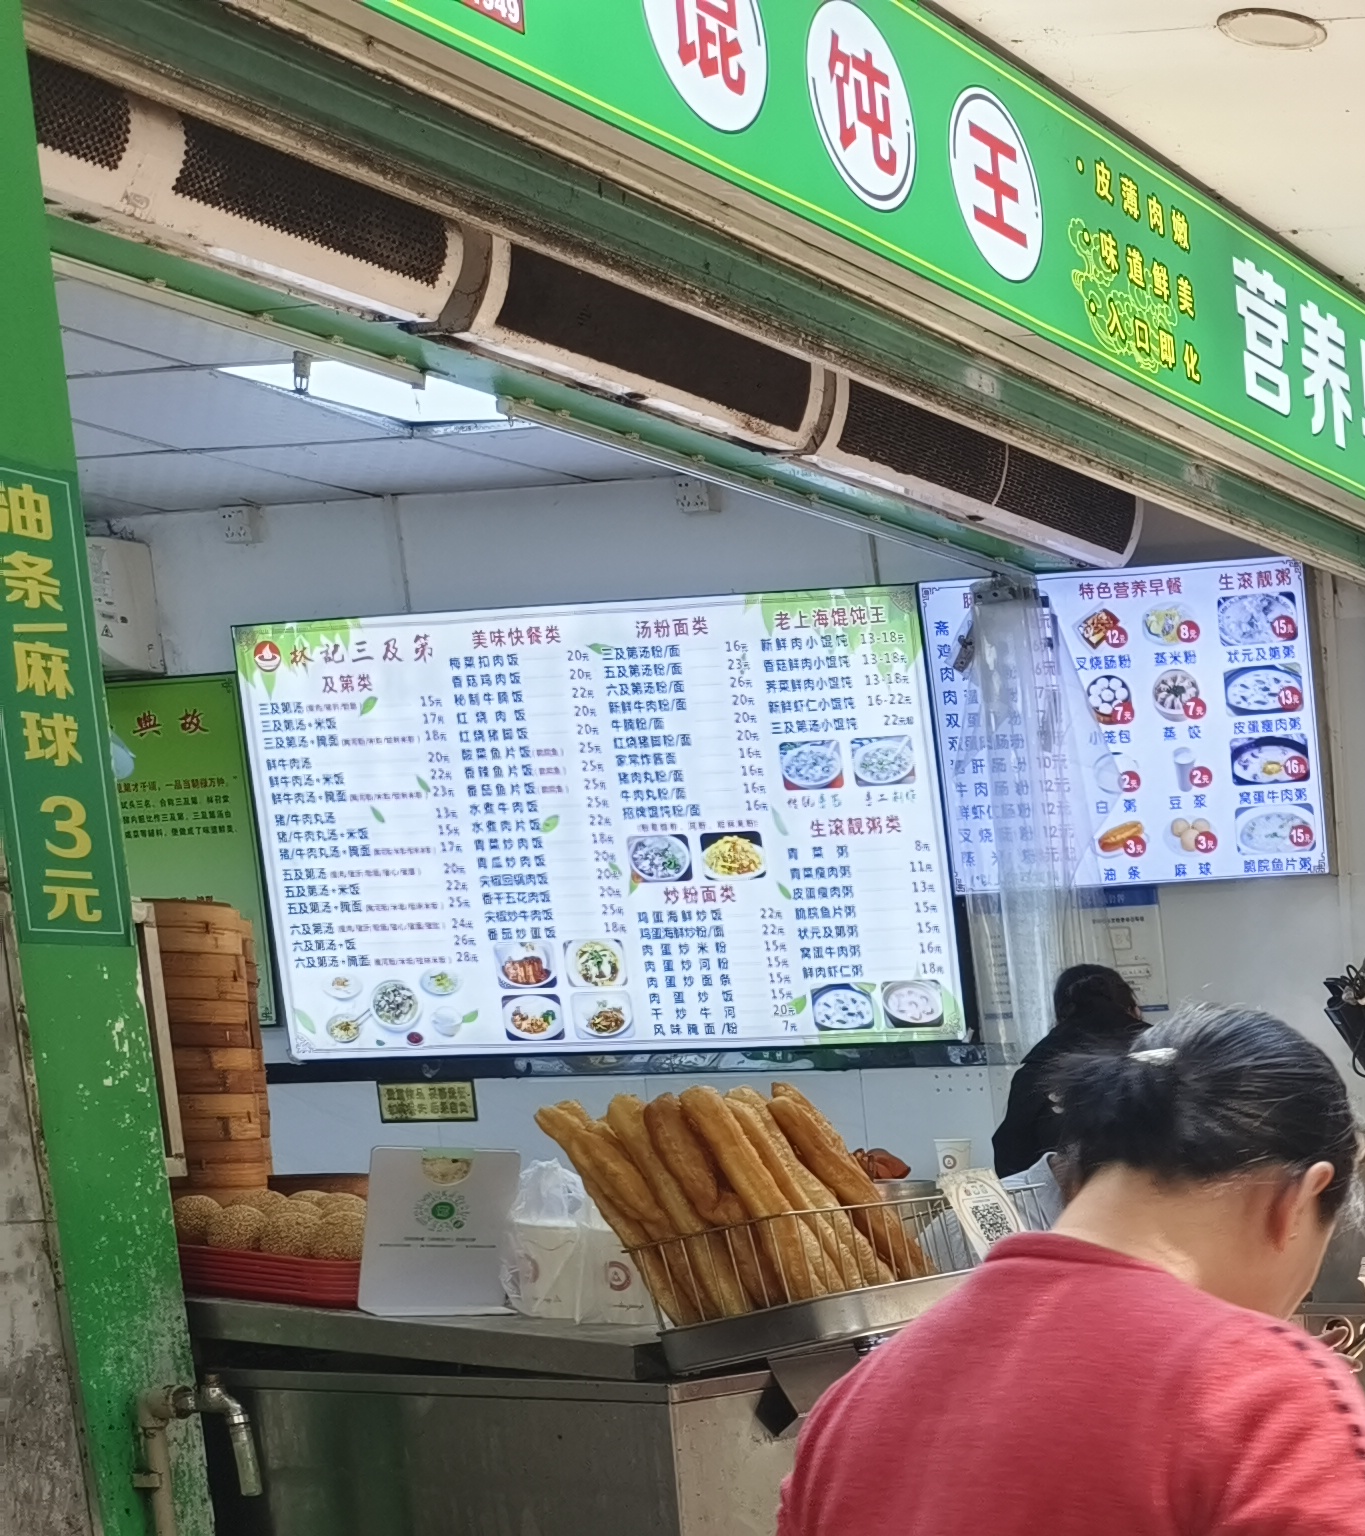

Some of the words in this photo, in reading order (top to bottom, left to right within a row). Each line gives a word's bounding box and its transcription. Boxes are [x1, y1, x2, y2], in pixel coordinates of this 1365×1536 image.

[1094, 160, 1191, 252] 皮薄肉嫩
[1098, 230, 1195, 318] 味道鲜美
[1107, 298, 1202, 385] 入口即化
[1218, 569, 1292, 591] 生滚靓粥
[1079, 577, 1182, 600] 特色营养早餐
[774, 605, 886, 631] 老上海馄饨王
[636, 616, 709, 639] 汤粉面类
[1180, 625, 1197, 639] 8元
[1273, 620, 1293, 635] 15元
[472, 625, 561, 649] 美味快餐类
[860, 632, 905, 644] 13-18元
[1106, 629, 1126, 644] 12元
[725, 641, 748, 652] 16元
[567, 650, 590, 662] 20元
[862, 653, 907, 665] 13-18元
[728, 659, 750, 670] 23元
[569, 668, 592, 680] 20元
[865, 674, 910, 686] 13-18元
[730, 676, 752, 688] 26元
[572, 687, 594, 699] 22元
[1279, 690, 1299, 704] 13元
[420, 696, 443, 707] 15元
[732, 694, 755, 706] 20元
[867, 694, 912, 706] 16-22元
[574, 705, 597, 717] 20元
[1113, 707, 1131, 720] 7元
[1186, 702, 1204, 716] 7元
[423, 713, 444, 725] 17元
[734, 712, 757, 724] 20元
[425, 730, 447, 741] 18元
[576, 724, 599, 736] 20元
[736, 730, 760, 742] 20元
[579, 742, 602, 754] 25元
[739, 748, 762, 759] 16元
[428, 752, 450, 763] 20元
[581, 760, 604, 772] 25元
[741, 766, 764, 777] 16元
[1285, 760, 1306, 774] 16元
[430, 768, 452, 780] 22元
[1192, 770, 1210, 784] 2元
[584, 778, 607, 790] 25元
[743, 783, 766, 794] 16元
[1122, 776, 1138, 789] 2元
[433, 785, 455, 797] 23元
[586, 796, 609, 808] 25元
[745, 800, 768, 811] 16元
[435, 807, 458, 819] 13元
[589, 814, 612, 826] 22元
[438, 824, 459, 836] 15元
[809, 815, 902, 838] 生滚靓粥类
[1291, 829, 1311, 843] 15元
[440, 841, 463, 853] 17元
[915, 841, 930, 851] 8元
[1127, 840, 1143, 853] 3元
[1197, 835, 1215, 850] 3元
[594, 850, 616, 862] 20元
[443, 863, 466, 874] 20元
[910, 862, 933, 873] 11元
[596, 868, 619, 880] 20元
[446, 880, 468, 891] 22元
[912, 881, 935, 893] 13元
[599, 886, 622, 898] 20元
[448, 896, 470, 908] 25元
[915, 902, 938, 913] 15元
[601, 904, 624, 916] 25元
[760, 908, 783, 920] 22元
[451, 918, 474, 929] 24元
[604, 922, 627, 934] 18元
[762, 924, 785, 935] 22元
[917, 922, 940, 934] 15元
[454, 934, 476, 946] 26元
[765, 940, 787, 951] 15元
[919, 943, 942, 954] 16元
[456, 952, 479, 963] 28元
[767, 956, 789, 967] 15元
[921, 962, 944, 974] 18元
[769, 973, 792, 984] 15元
[771, 989, 793, 1000] 15元
[773, 1004, 796, 1016] 20元
[782, 1020, 798, 1032] 7元
